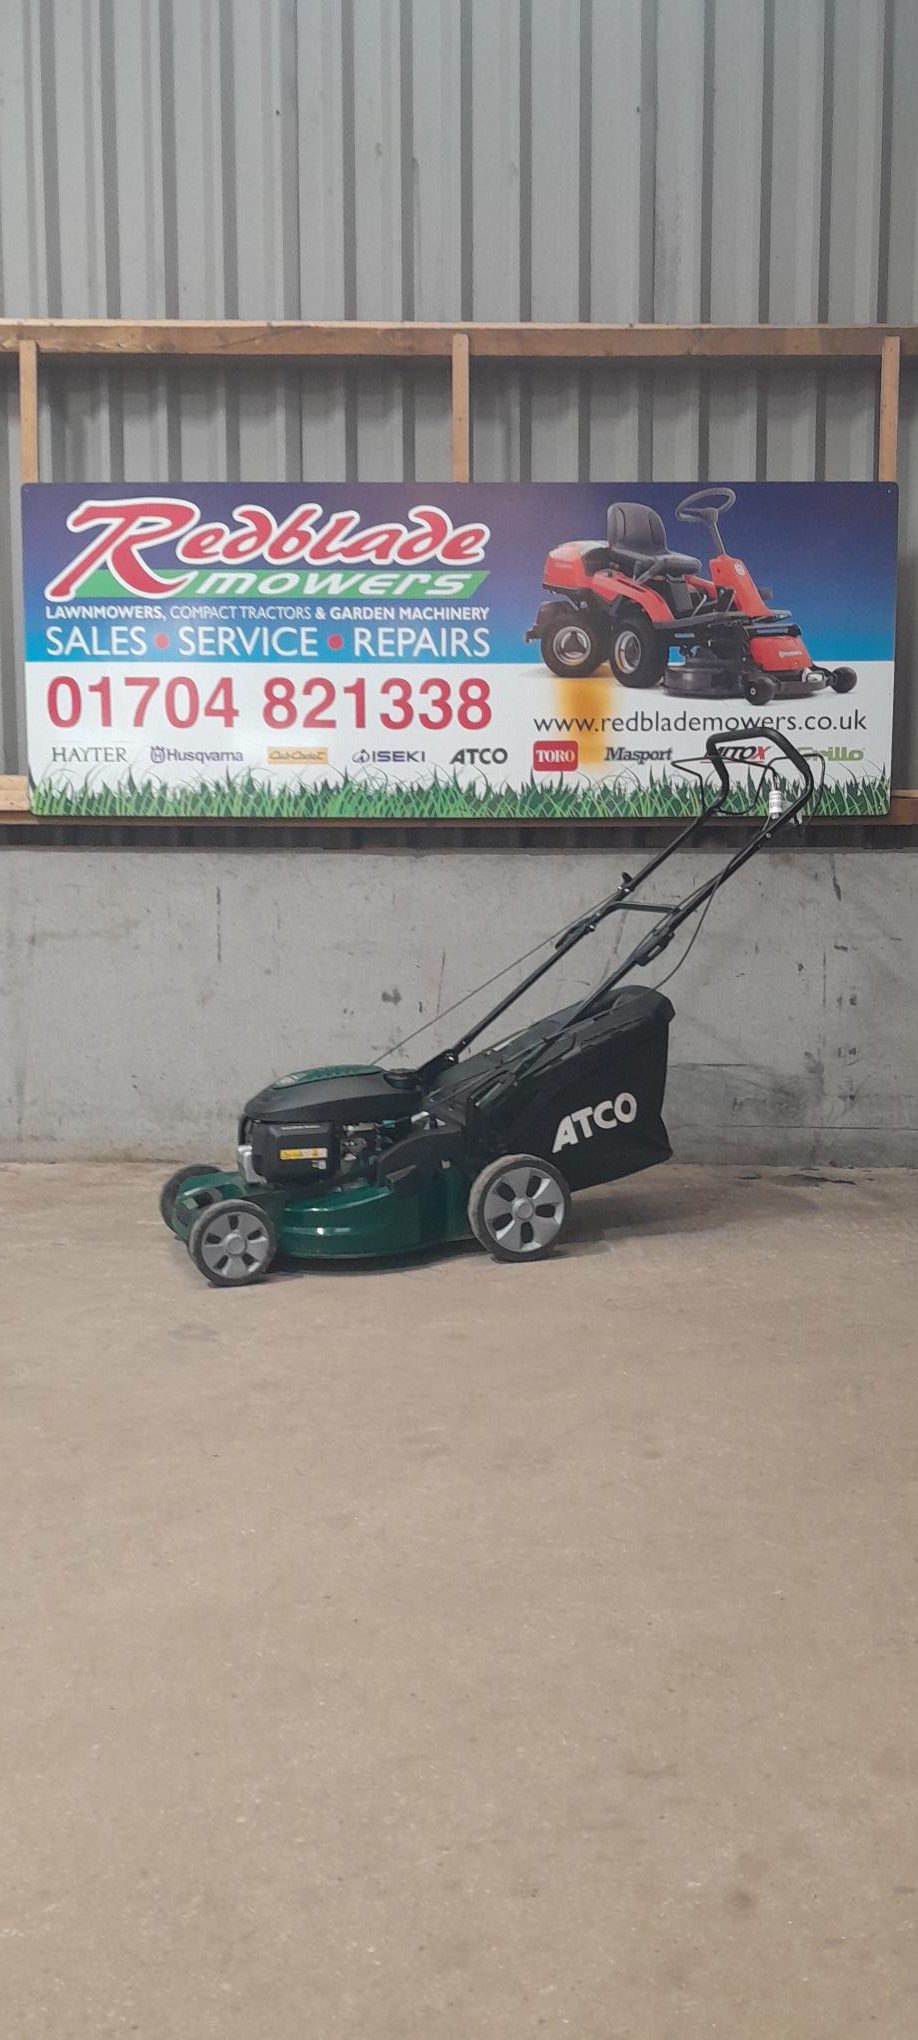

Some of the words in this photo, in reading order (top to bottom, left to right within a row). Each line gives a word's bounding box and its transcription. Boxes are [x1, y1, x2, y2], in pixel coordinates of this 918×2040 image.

[44, 497, 491, 601] Redblade
[45, 605, 166, 621] LAWNMOWERS,
[170, 606, 236, 620] COMPACT
[240, 606, 311, 620] TRACTORS
[314, 606, 326, 621] &
[330, 606, 395, 620] GARDEN
[399, 606, 490, 621] MACHINERY
[46, 626, 148, 656] SALES
[178, 626, 318, 657] SERVICE
[354, 627, 490, 657] REPAIRS
[46, 675, 240, 729] 01704
[262, 677, 493, 730] 821338
[533, 709, 868, 732] www.redblademowers.co.uk
[52, 746, 128, 762] HAYTER
[167, 749, 244, 764] Husqvarna
[372, 751, 426, 763] ISEKI
[450, 748, 508, 765] ATCO
[535, 749, 576, 763] TORO
[604, 747, 673, 764] Masport
[552, 1092, 637, 1153] ATCO
